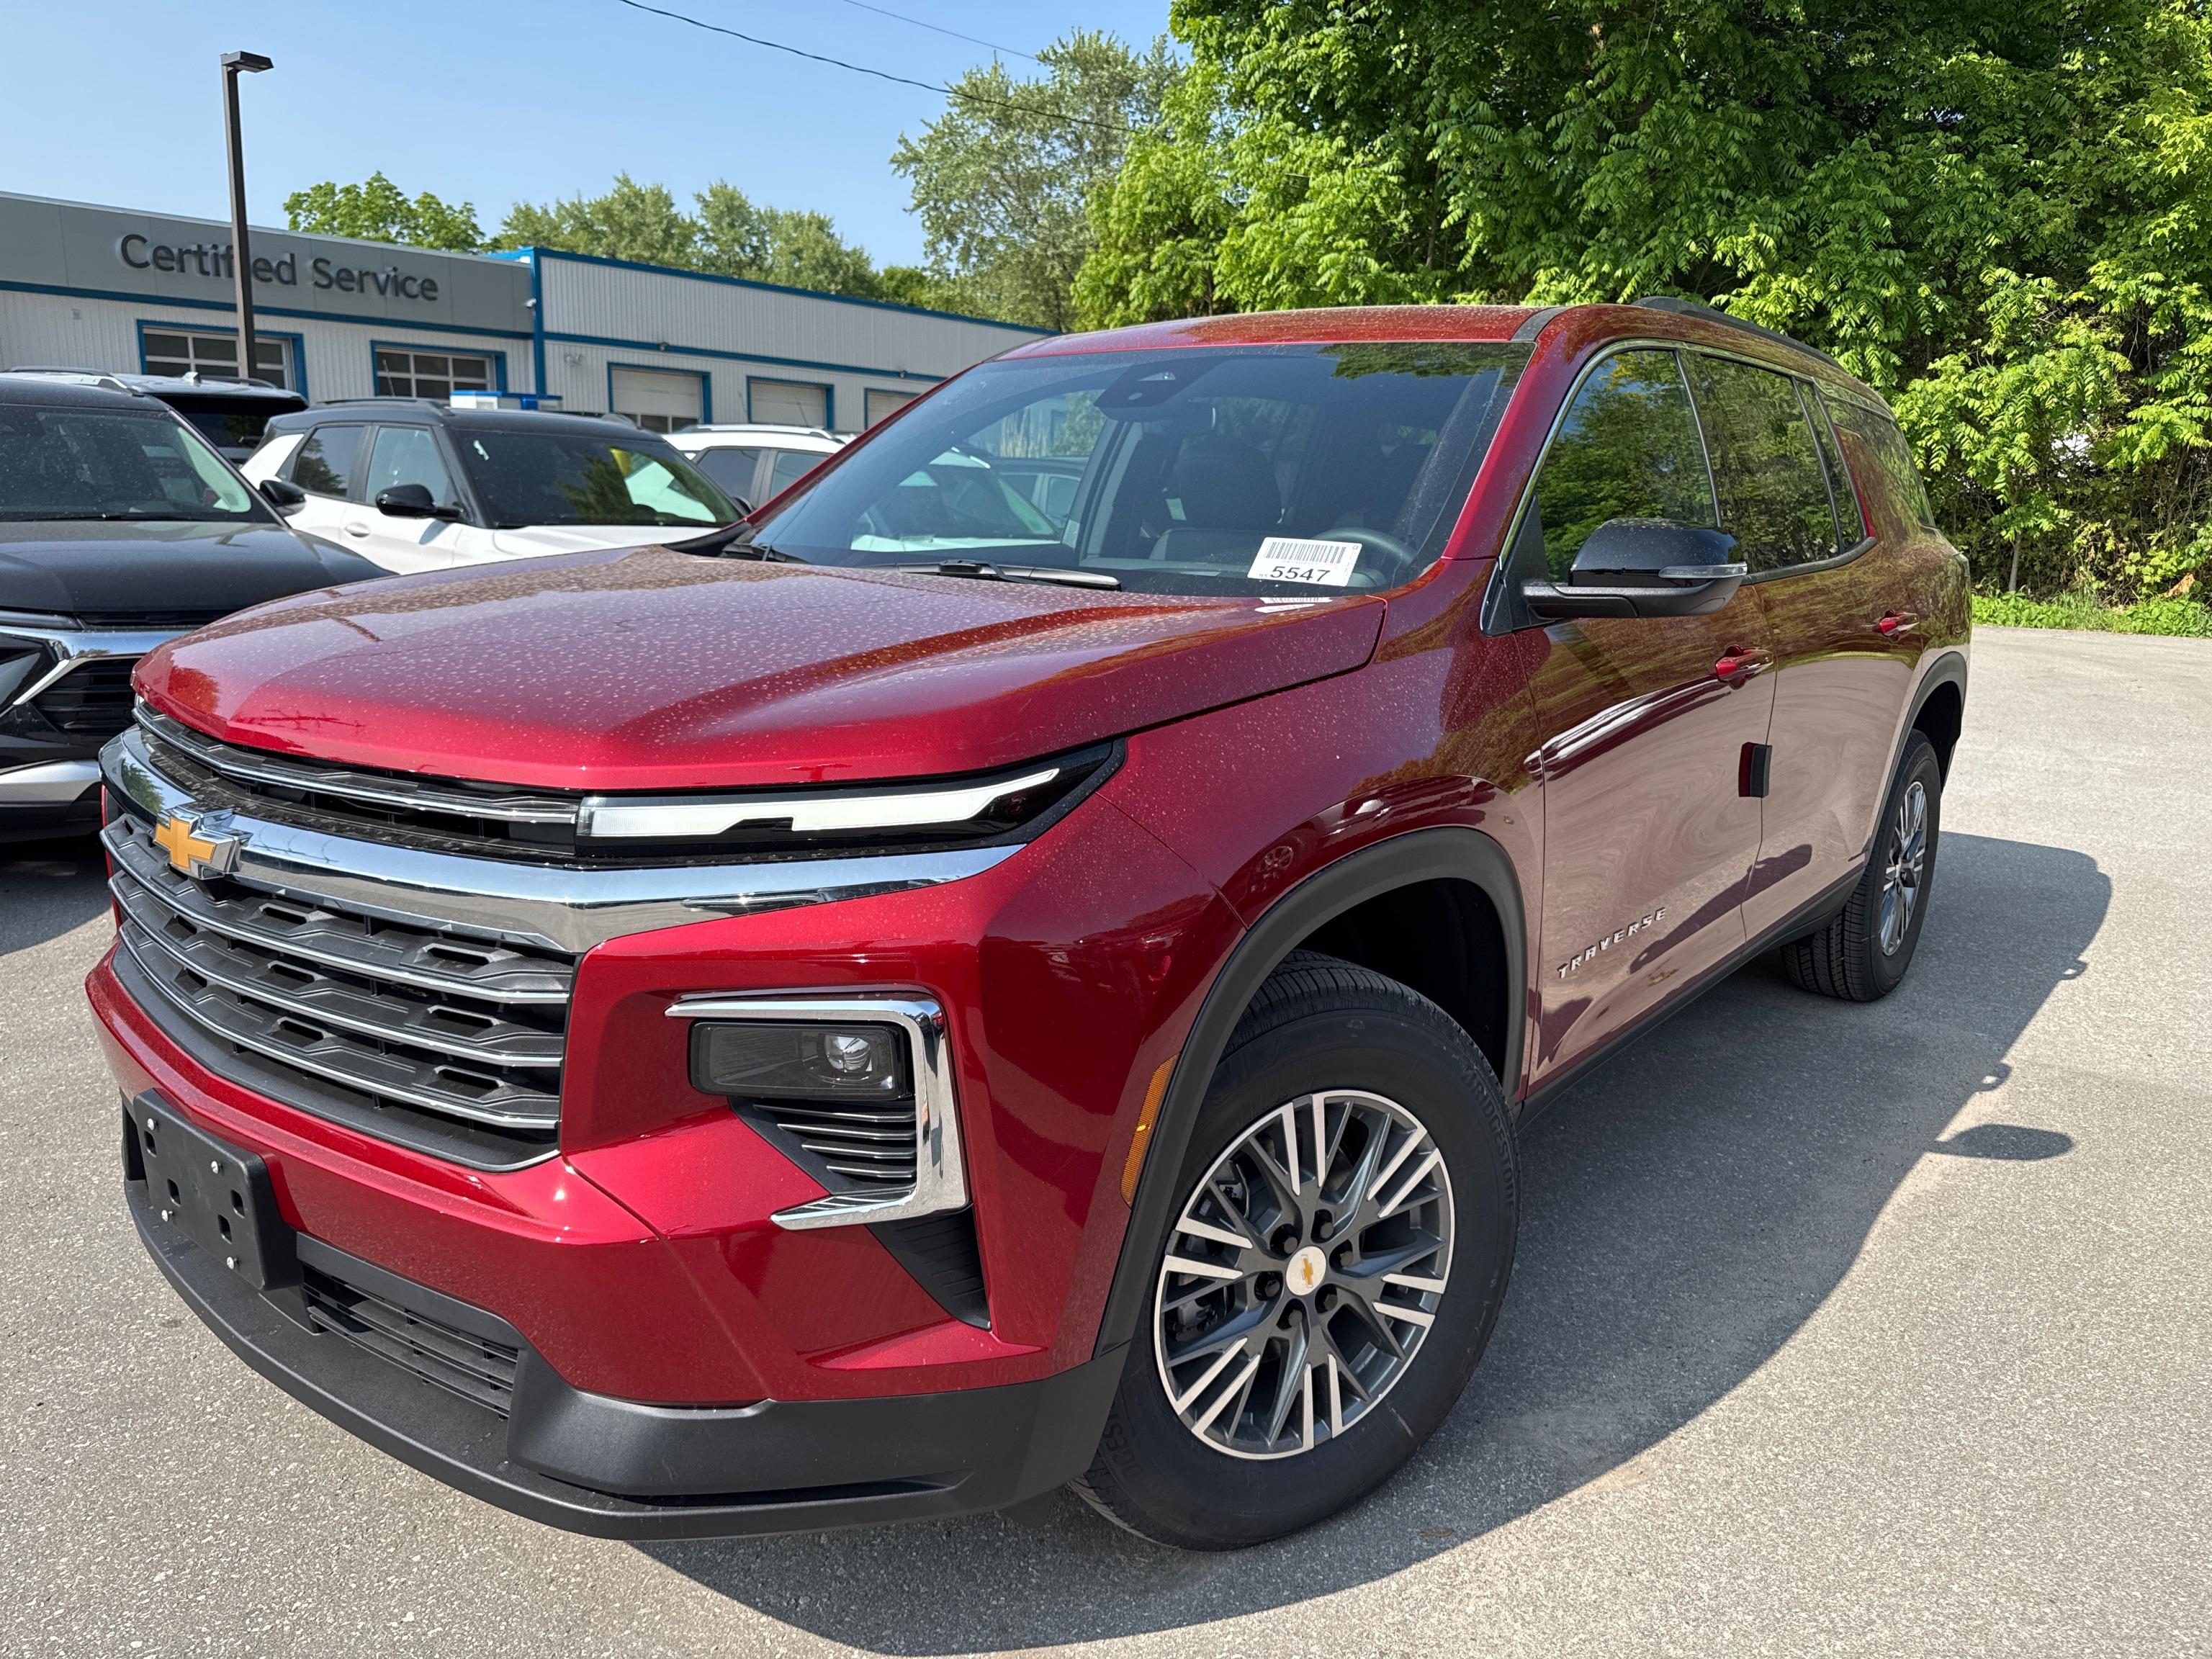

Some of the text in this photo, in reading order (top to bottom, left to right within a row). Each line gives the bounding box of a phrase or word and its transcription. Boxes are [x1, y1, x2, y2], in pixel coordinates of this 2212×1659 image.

[120, 234, 439, 301] Certifed Service
[1270, 565, 1331, 583] 5547
[1557, 907, 1666, 979] TRAVERSE
